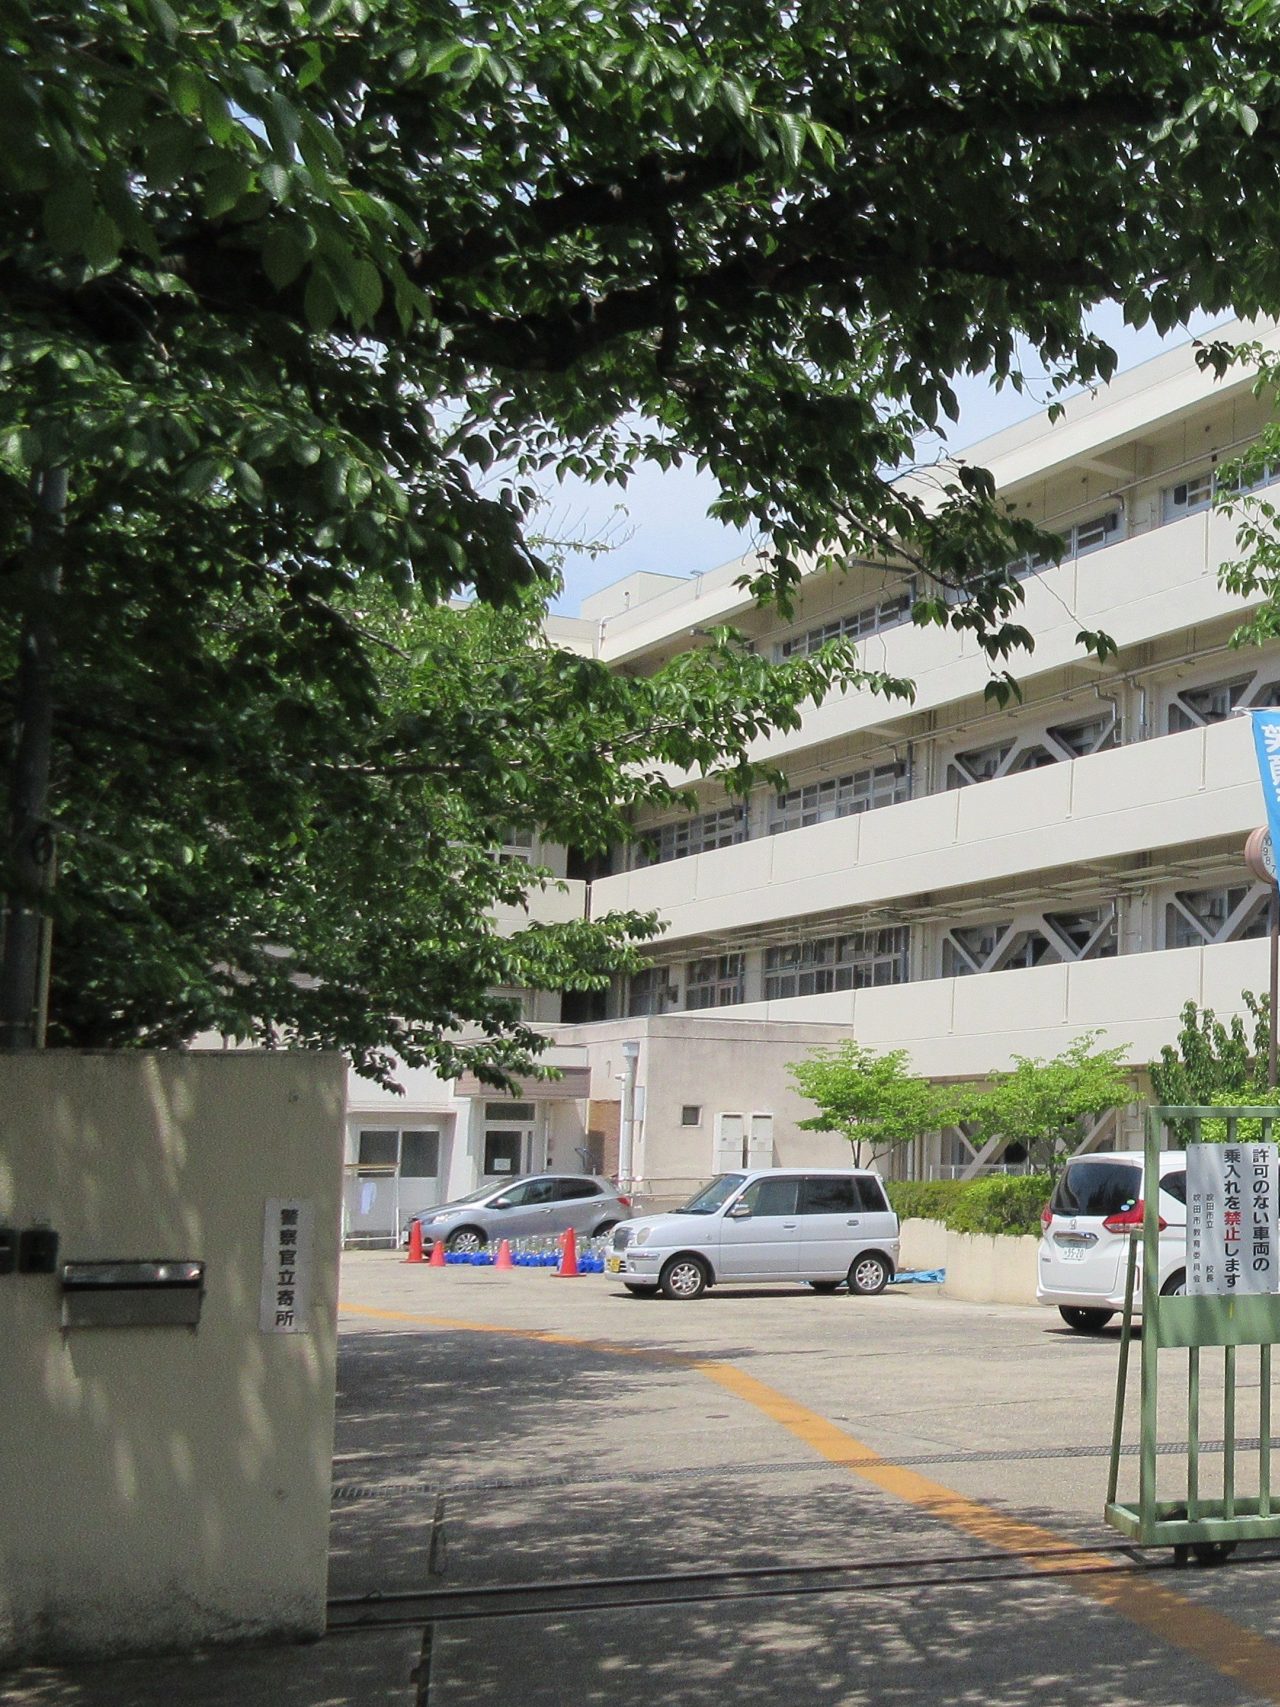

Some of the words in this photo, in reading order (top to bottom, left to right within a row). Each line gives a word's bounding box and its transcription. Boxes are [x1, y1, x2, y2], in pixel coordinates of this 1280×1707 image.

[275, 1208, 299, 1326] 警察官立寄所
[1224, 1149, 1241, 1288] 乗入れを禁止します
[1252, 1149, 1270, 1272] 許可のない車両の
